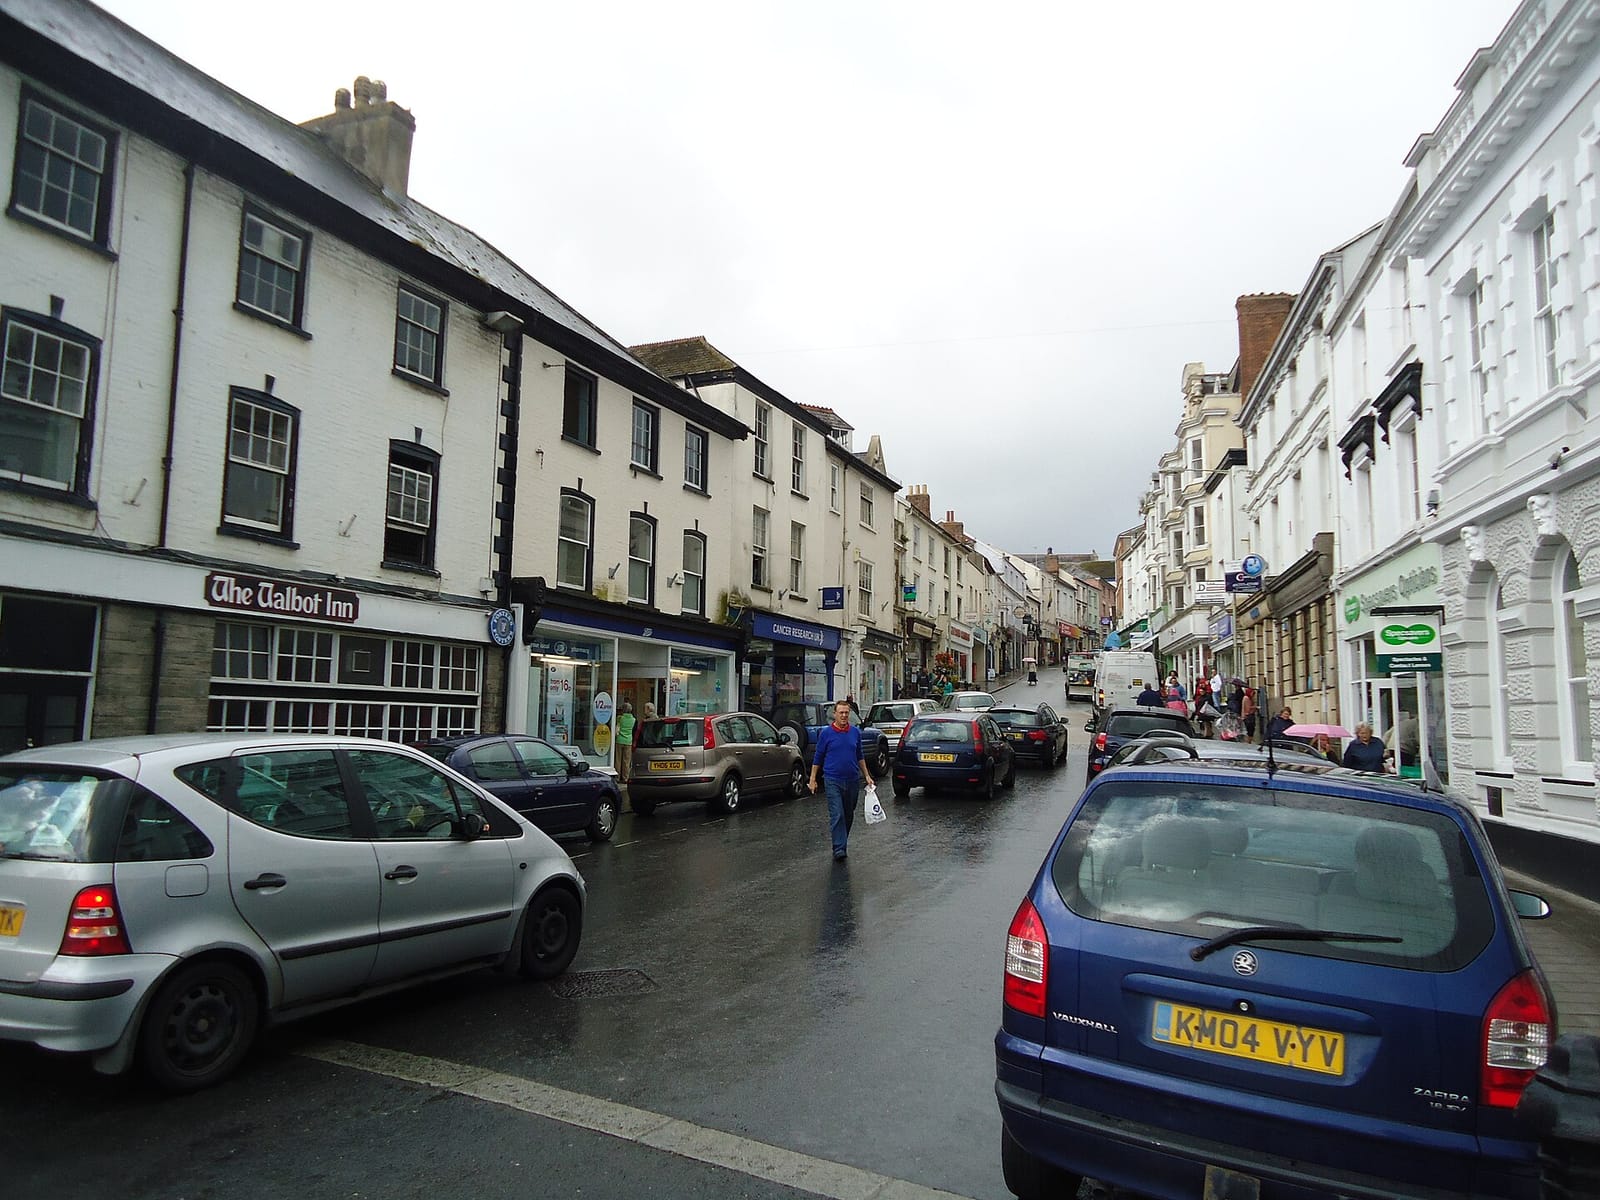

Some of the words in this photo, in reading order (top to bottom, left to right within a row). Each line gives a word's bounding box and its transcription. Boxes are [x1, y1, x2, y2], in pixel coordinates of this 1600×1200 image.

[211, 575, 254, 605] The
[257, 581, 323, 614] Talbot
[326, 591, 353, 618] Inn
[772, 623, 792, 636] CANCER
[792, 629, 814, 641] RESEARCH
[1385, 630, 1430, 638] Specsavers
[1052, 1011, 1118, 1034] VAUXHALL
[1175, 1010, 1260, 1054] KM04
[1273, 1026, 1339, 1068] VYV
[1413, 1087, 1470, 1102] ZAFIRA
